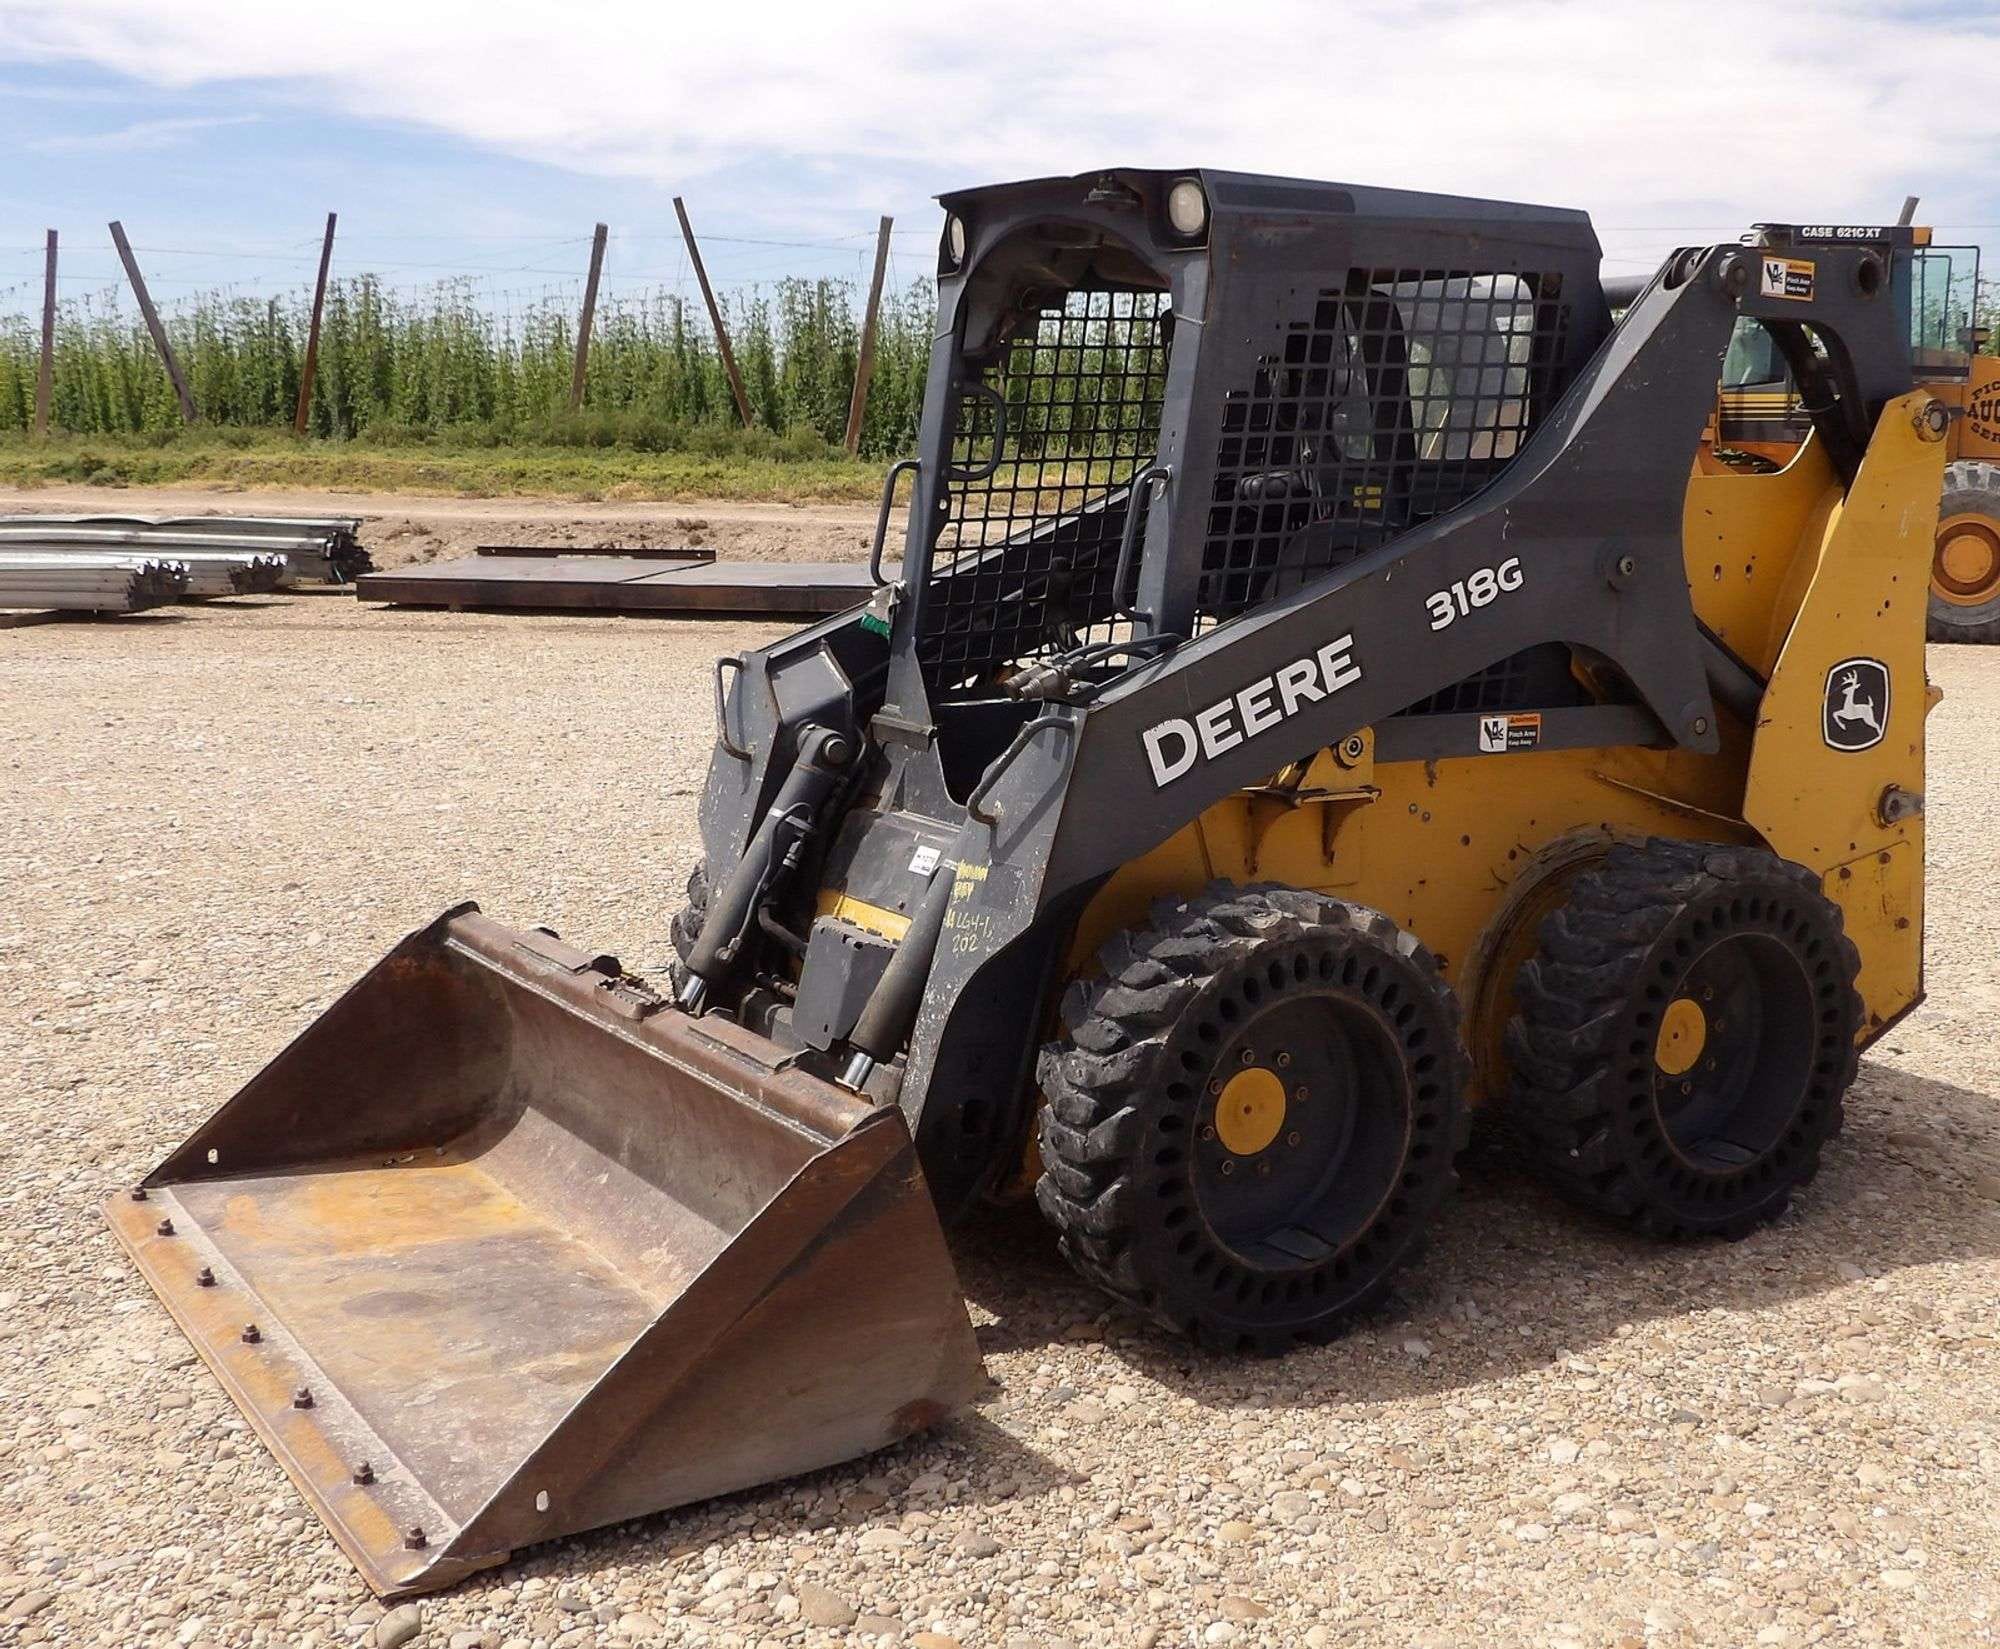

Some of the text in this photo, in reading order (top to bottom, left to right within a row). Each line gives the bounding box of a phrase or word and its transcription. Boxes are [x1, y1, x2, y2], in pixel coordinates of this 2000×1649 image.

[1802, 227, 1833, 238] CASE
[1425, 557, 1524, 631] 318G
[1142, 633, 1362, 788] DEERE
